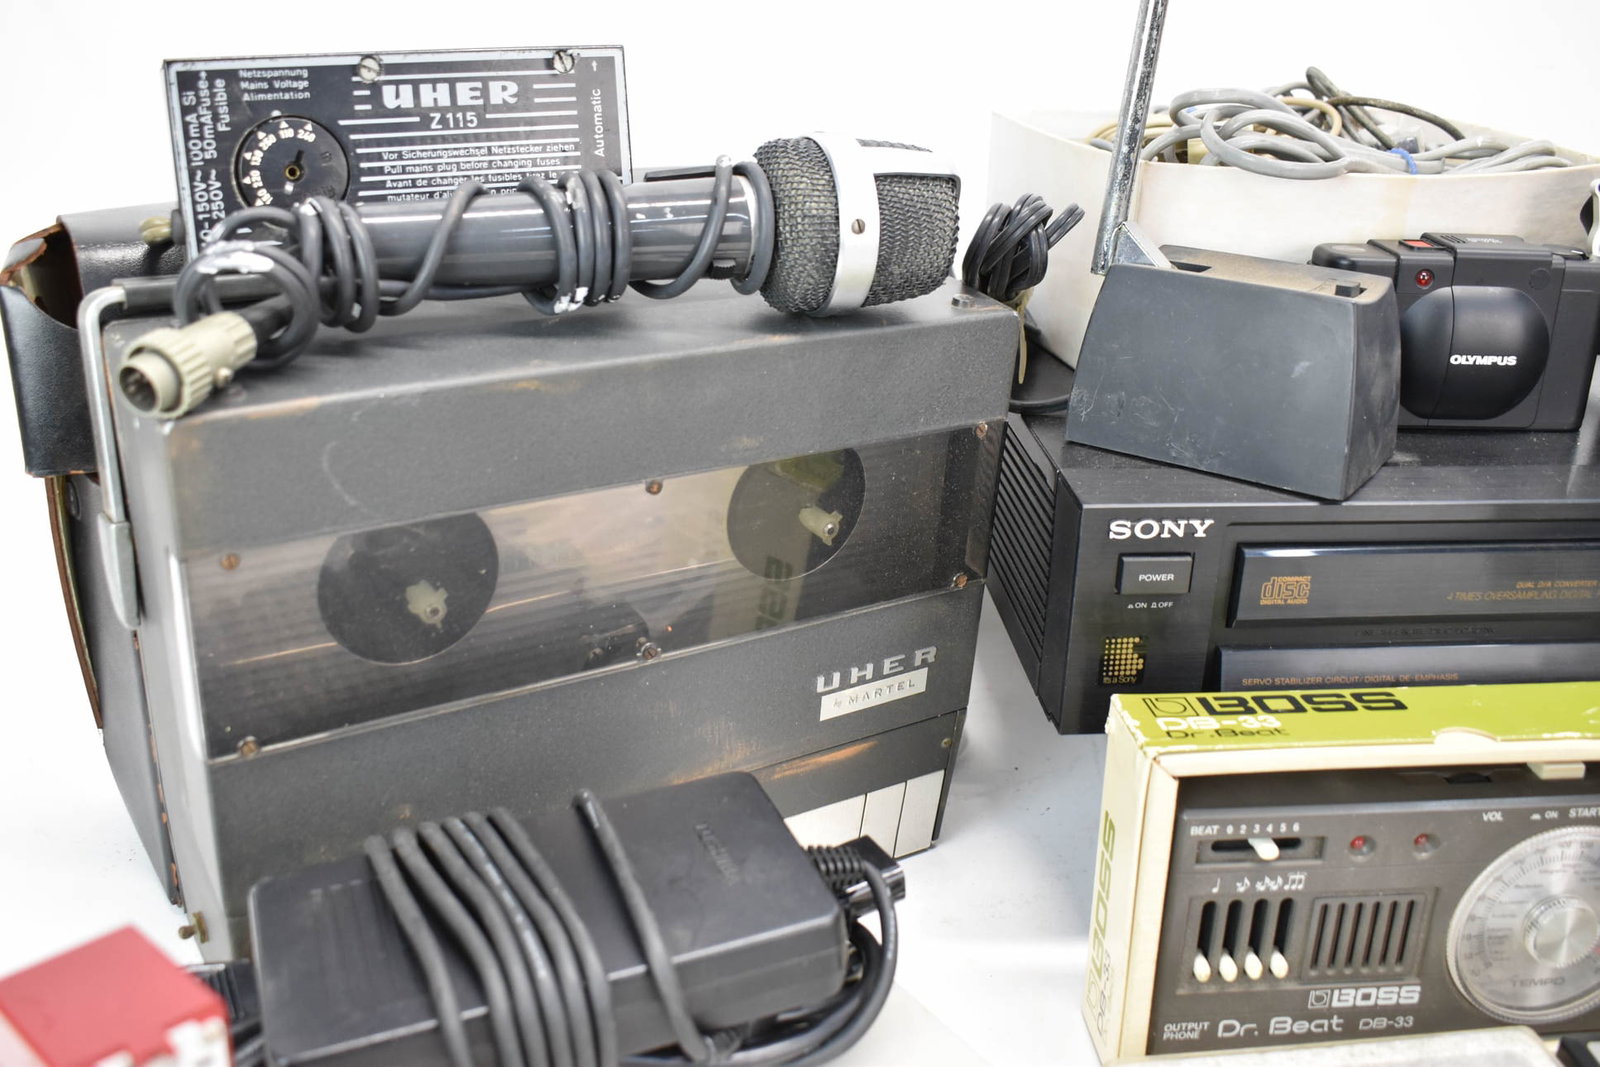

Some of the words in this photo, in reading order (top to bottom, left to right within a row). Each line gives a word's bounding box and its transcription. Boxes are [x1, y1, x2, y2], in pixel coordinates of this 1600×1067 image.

[238, 69, 309, 79] Netzspannung
[240, 80, 270, 90] Mains
[273, 79, 310, 90] Voltage
[181, 90, 197, 106] Si
[242, 91, 311, 101] Alimentation
[212, 78, 232, 131] Fusible
[590, 88, 606, 157] Automatic
[382, 151, 399, 160] Vor
[401, 147, 488, 159] Sicherungswechsel
[491, 144, 543, 155] Netzstecker
[546, 143, 575, 152] ziehen
[384, 164, 403, 174] Pull
[405, 164, 434, 173] mains
[437, 162, 458, 173] plug
[460, 160, 489, 171] before
[492, 158, 533, 169] changing
[537, 157, 561, 166] fuses
[385, 179, 413, 188] Avant
[415, 178, 428, 187] de
[431, 176, 467, 185] changer
[471, 174, 485, 183] les
[488, 172, 523, 182] fusibles
[387, 193, 430, 202] mutateur
[1450, 354, 1517, 366] OLYMPUS
[1109, 519, 1215, 540] SONY
[1138, 573, 1175, 582] POWER
[1158, 601, 1174, 609] OFF
[816, 645, 938, 694] UHER
[1241, 678, 1272, 687] SERVO
[1274, 677, 1322, 686] STABILIZER
[848, 679, 916, 705] MARTEL
[1196, 691, 1408, 716] BOSS
[1155, 714, 1282, 732] DB-33
[1482, 810, 1504, 822] VOL
[1544, 810, 1559, 819] ON
[1190, 825, 1220, 836] BEAT
[1239, 823, 1247, 835] 2
[1252, 823, 1260, 834] 3
[1266, 823, 1273, 833] 4
[1279, 822, 1287, 833] 5
[1293, 822, 1300, 832] 6
[1091, 810, 1116, 981] BOSS
[1513, 976, 1566, 988] TEMPO
[1331, 985, 1421, 1008] BOSS
[1164, 1021, 1210, 1032] OUTPUT
[1217, 1018, 1259, 1038] Dr.
[1268, 1015, 1345, 1036] Beat
[1358, 1015, 1415, 1031] DB-33
[1163, 1031, 1201, 1040] PHONE
